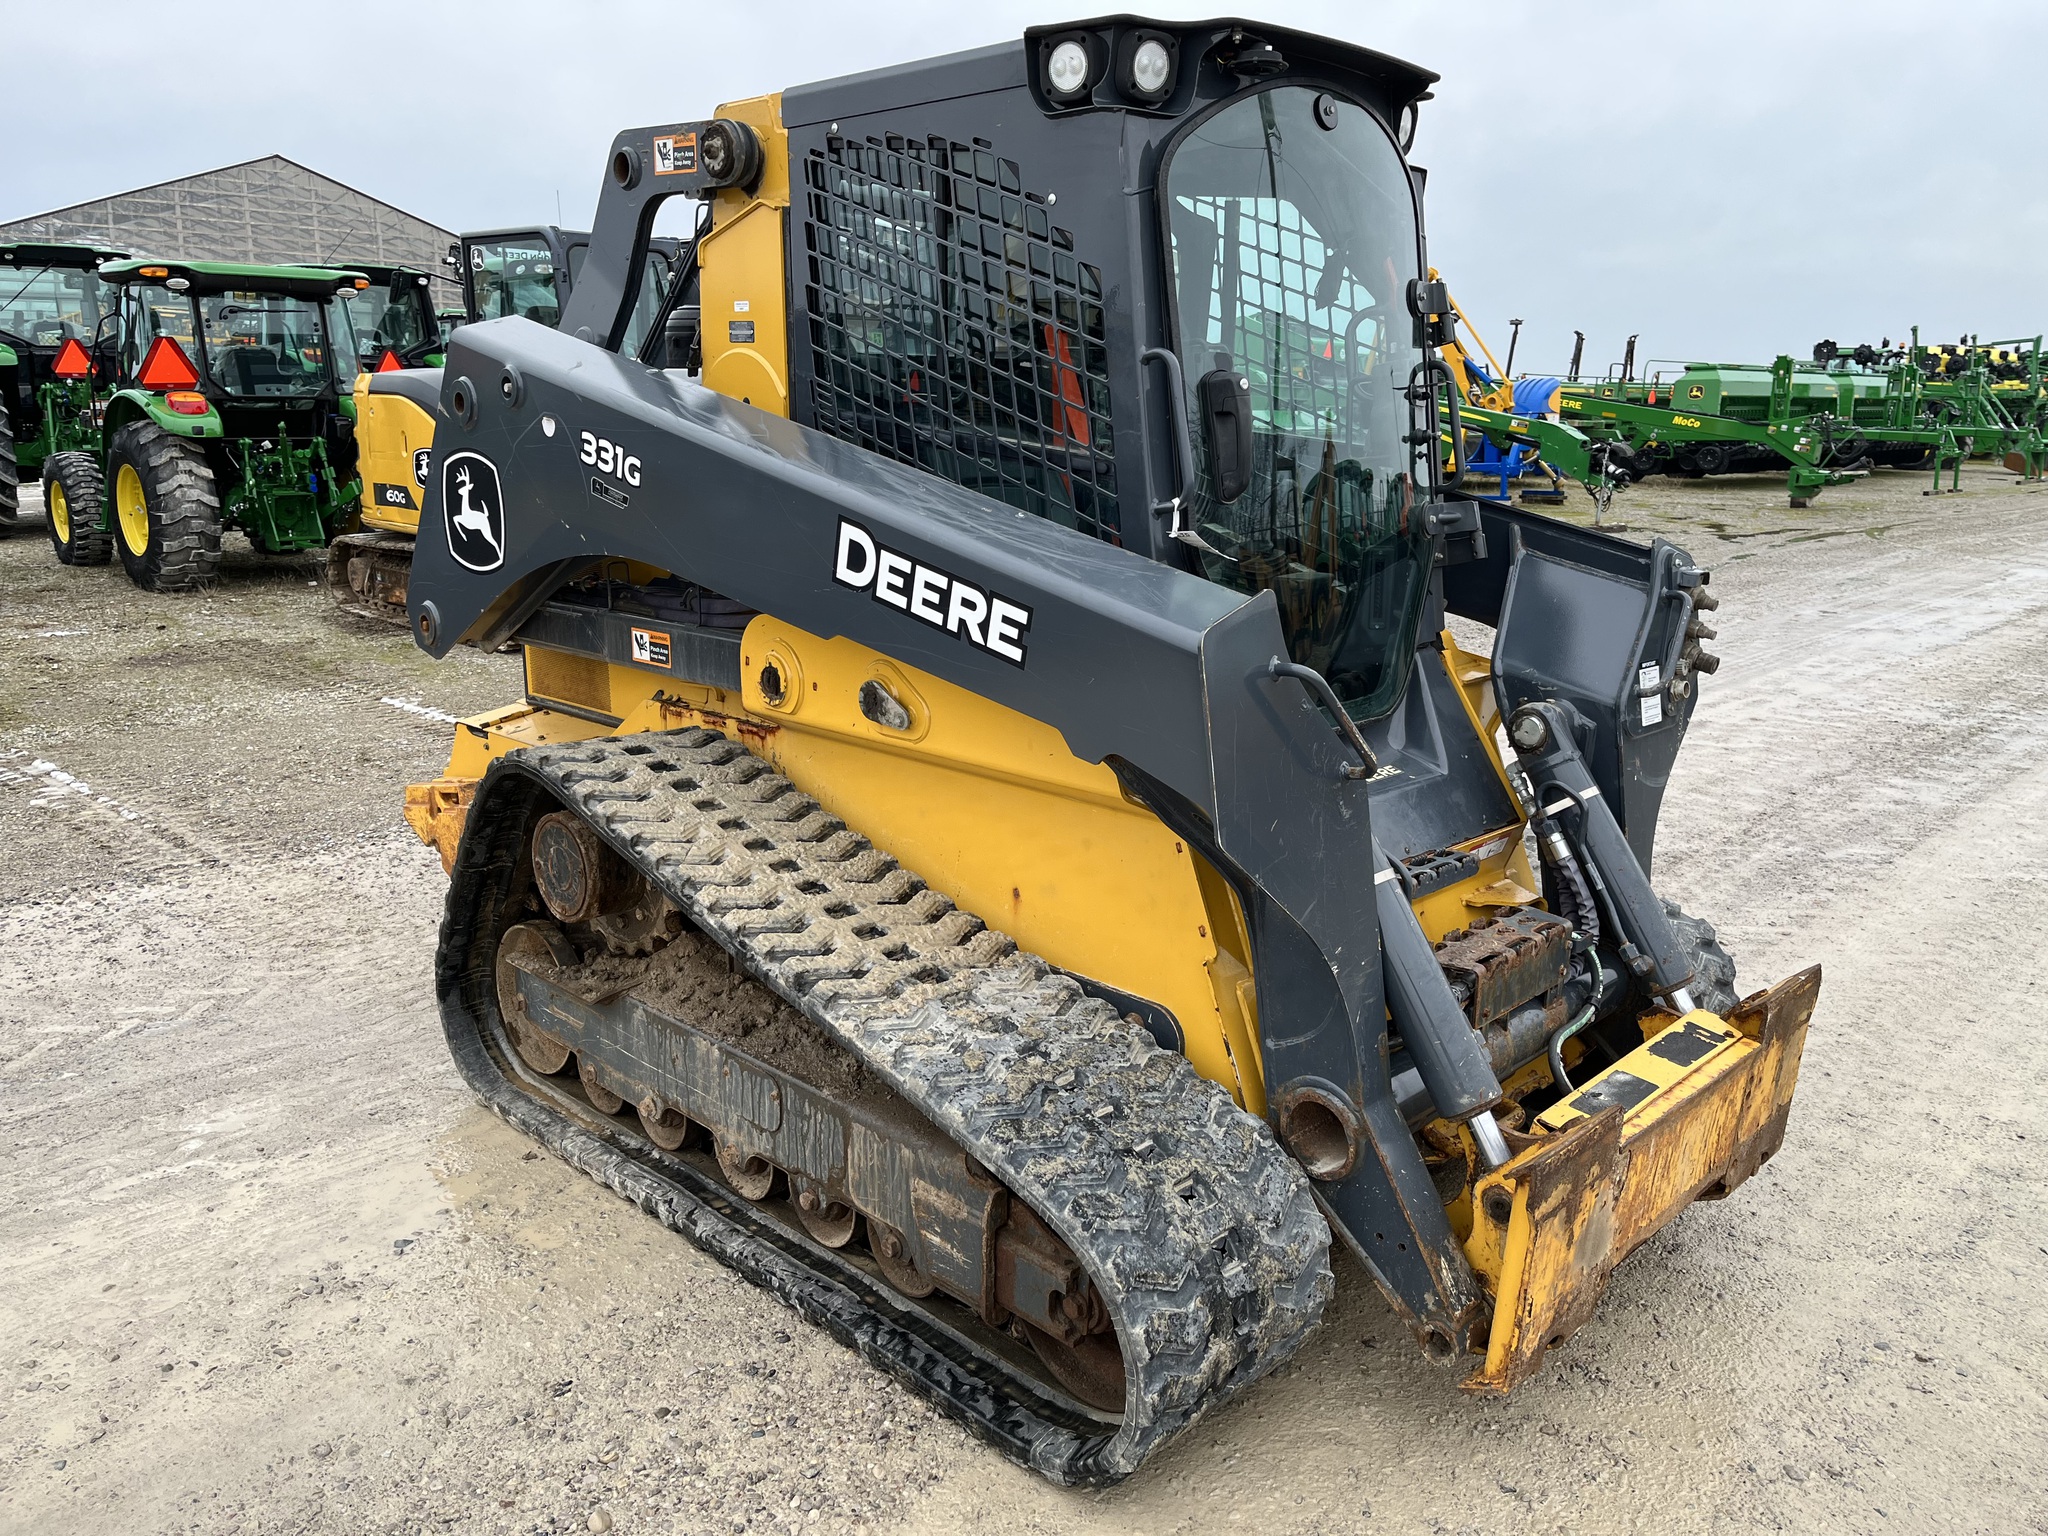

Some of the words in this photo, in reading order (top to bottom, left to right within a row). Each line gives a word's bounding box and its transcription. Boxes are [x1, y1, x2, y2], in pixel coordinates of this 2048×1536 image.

[1559, 398, 1583, 410] ERE
[1672, 415, 1701, 428] MoCo
[580, 431, 641, 487] 331G
[386, 489, 406, 504] 60G
[835, 521, 1029, 663] DEERE
[1365, 765, 1402, 782] ERE
